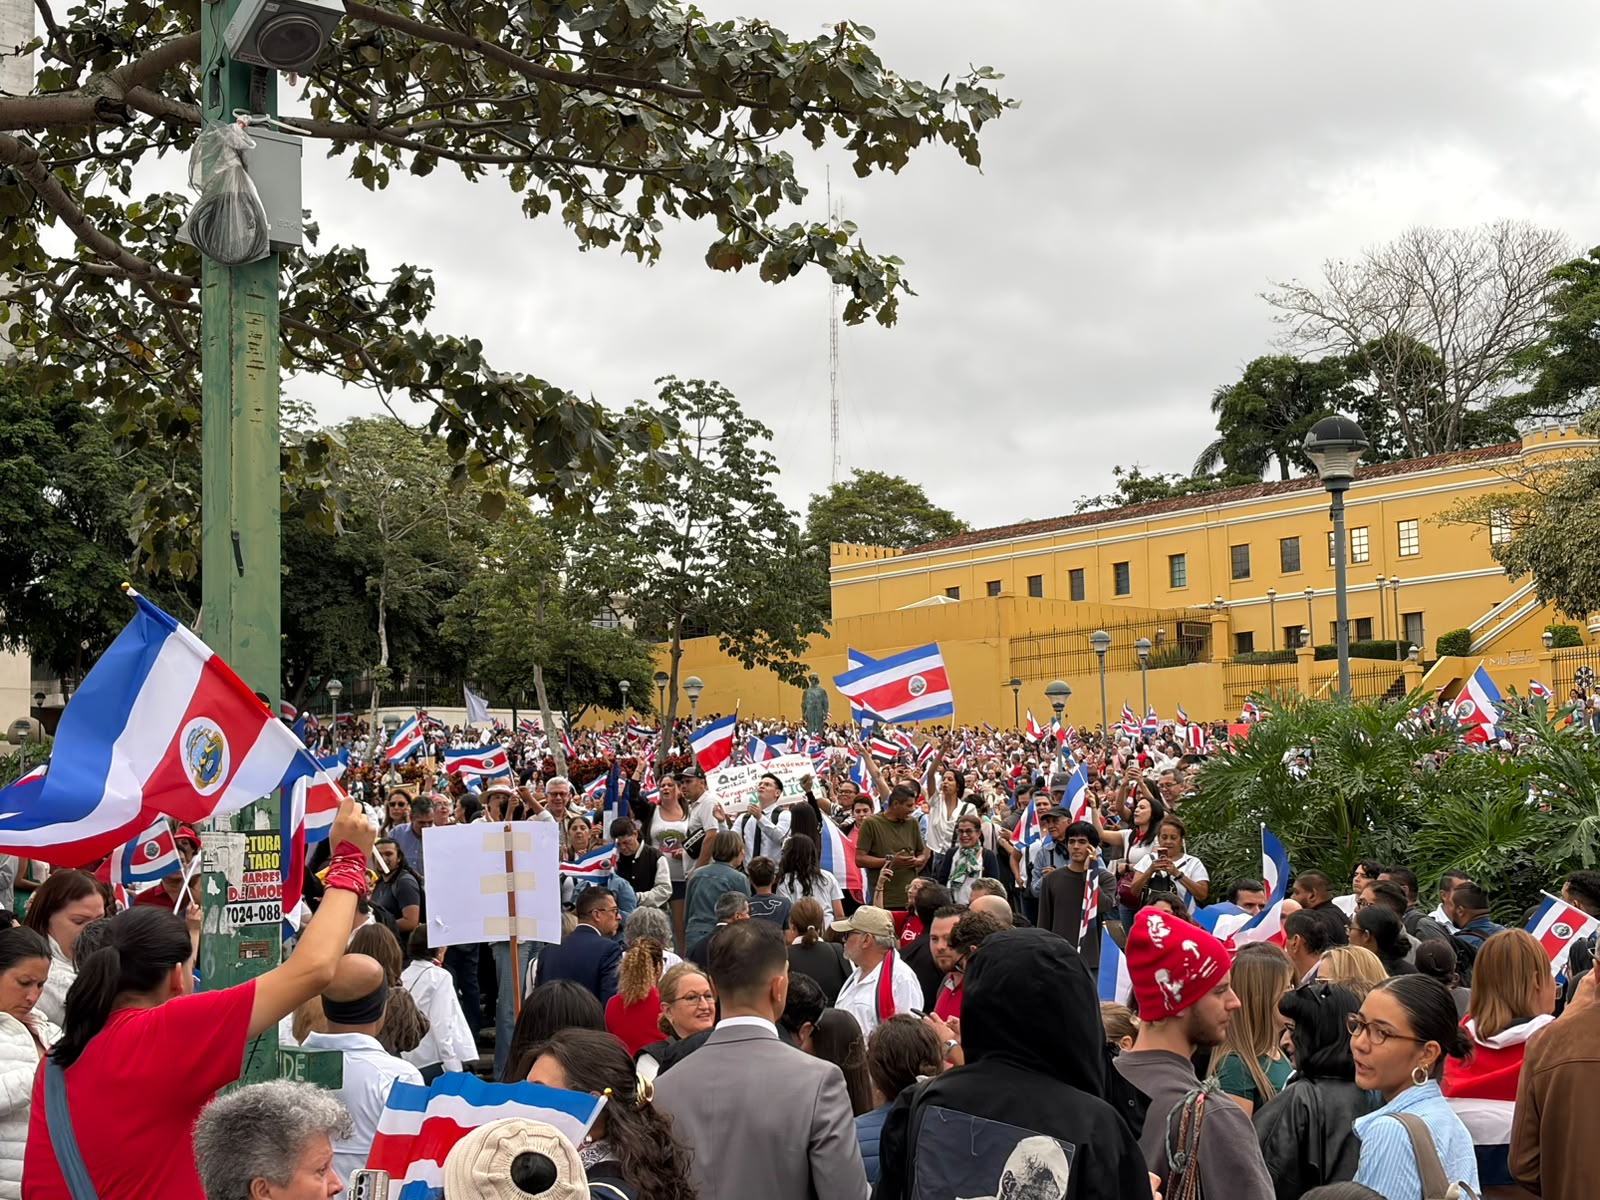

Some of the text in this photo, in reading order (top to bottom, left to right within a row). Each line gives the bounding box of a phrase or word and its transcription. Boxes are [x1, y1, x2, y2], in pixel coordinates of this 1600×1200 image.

[1489, 655, 1537, 666] MUSEO
[718, 772, 745, 785] Que
[244, 834, 281, 852] CTURA
[248, 852, 281, 870] TARO
[242, 871, 280, 884] MARRES
[226, 904, 280, 923] 7024-088
